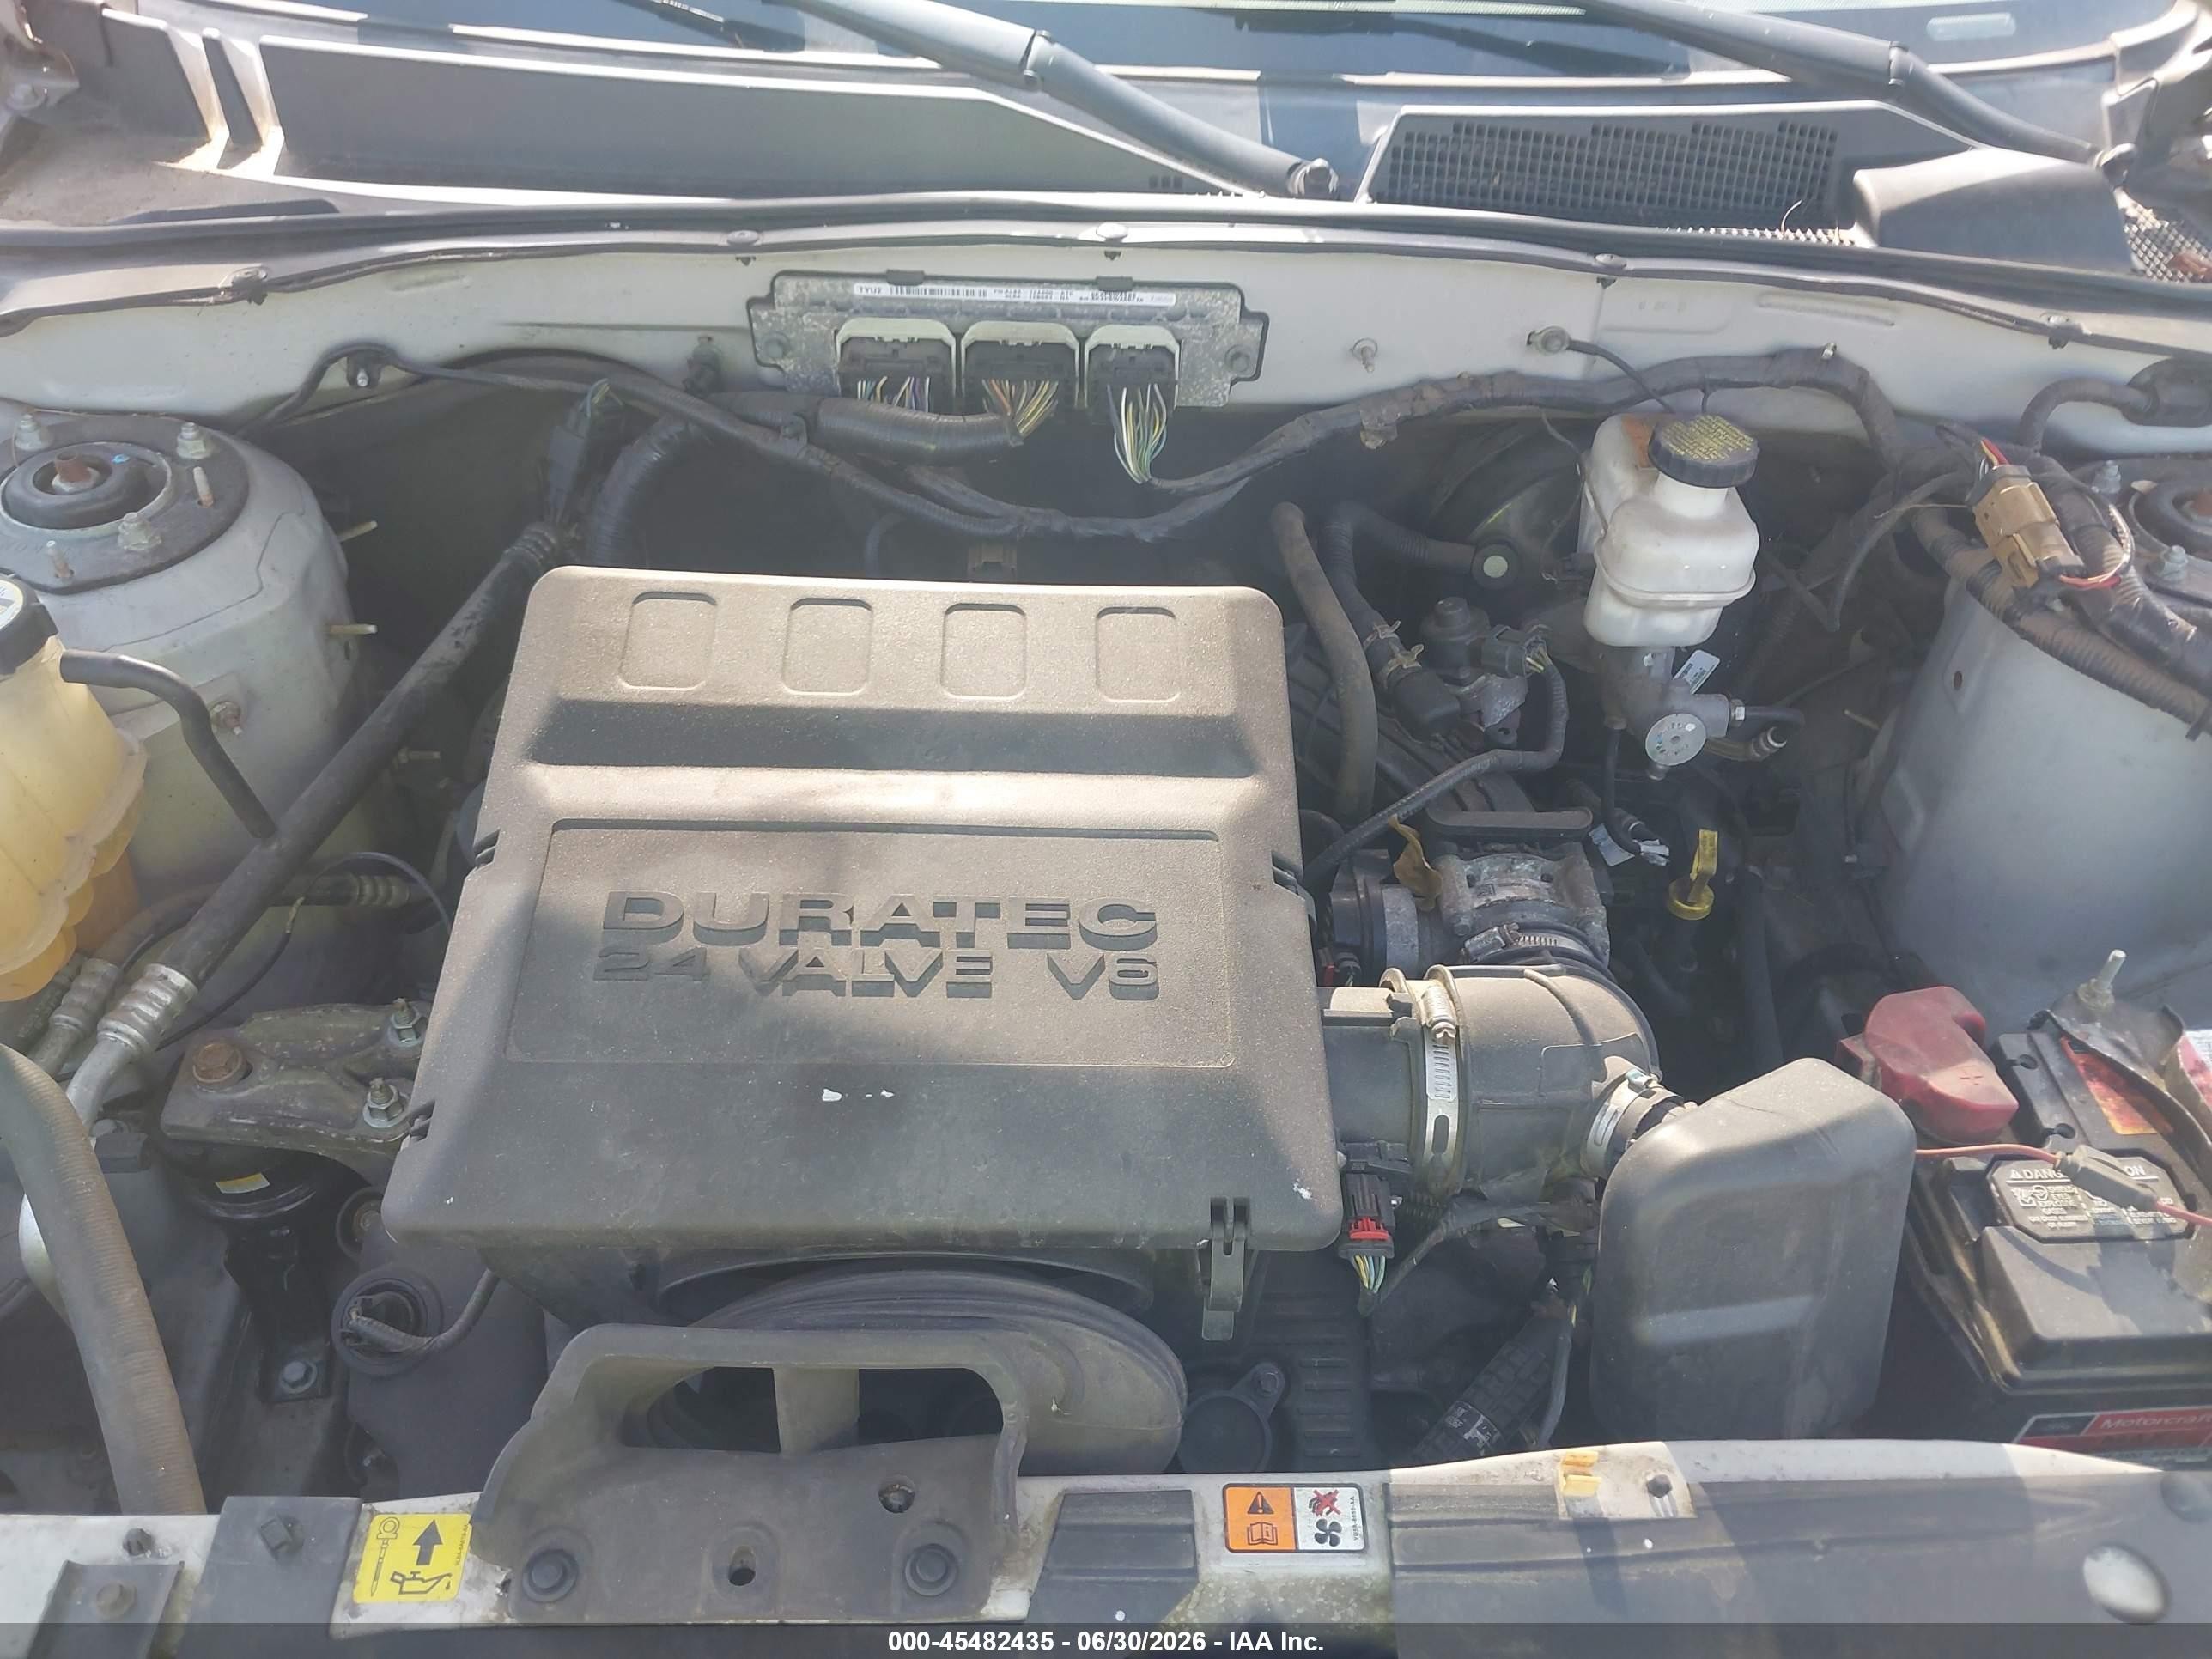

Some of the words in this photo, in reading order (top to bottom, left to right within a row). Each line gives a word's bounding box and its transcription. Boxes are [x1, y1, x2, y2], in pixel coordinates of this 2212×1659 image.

[603, 891, 1158, 950] DURATEC
[593, 947, 707, 981] 24
[738, 947, 993, 998] VALVE
[1047, 951, 1160, 1000] V6
[2023, 1169, 2068, 1179] DANG
